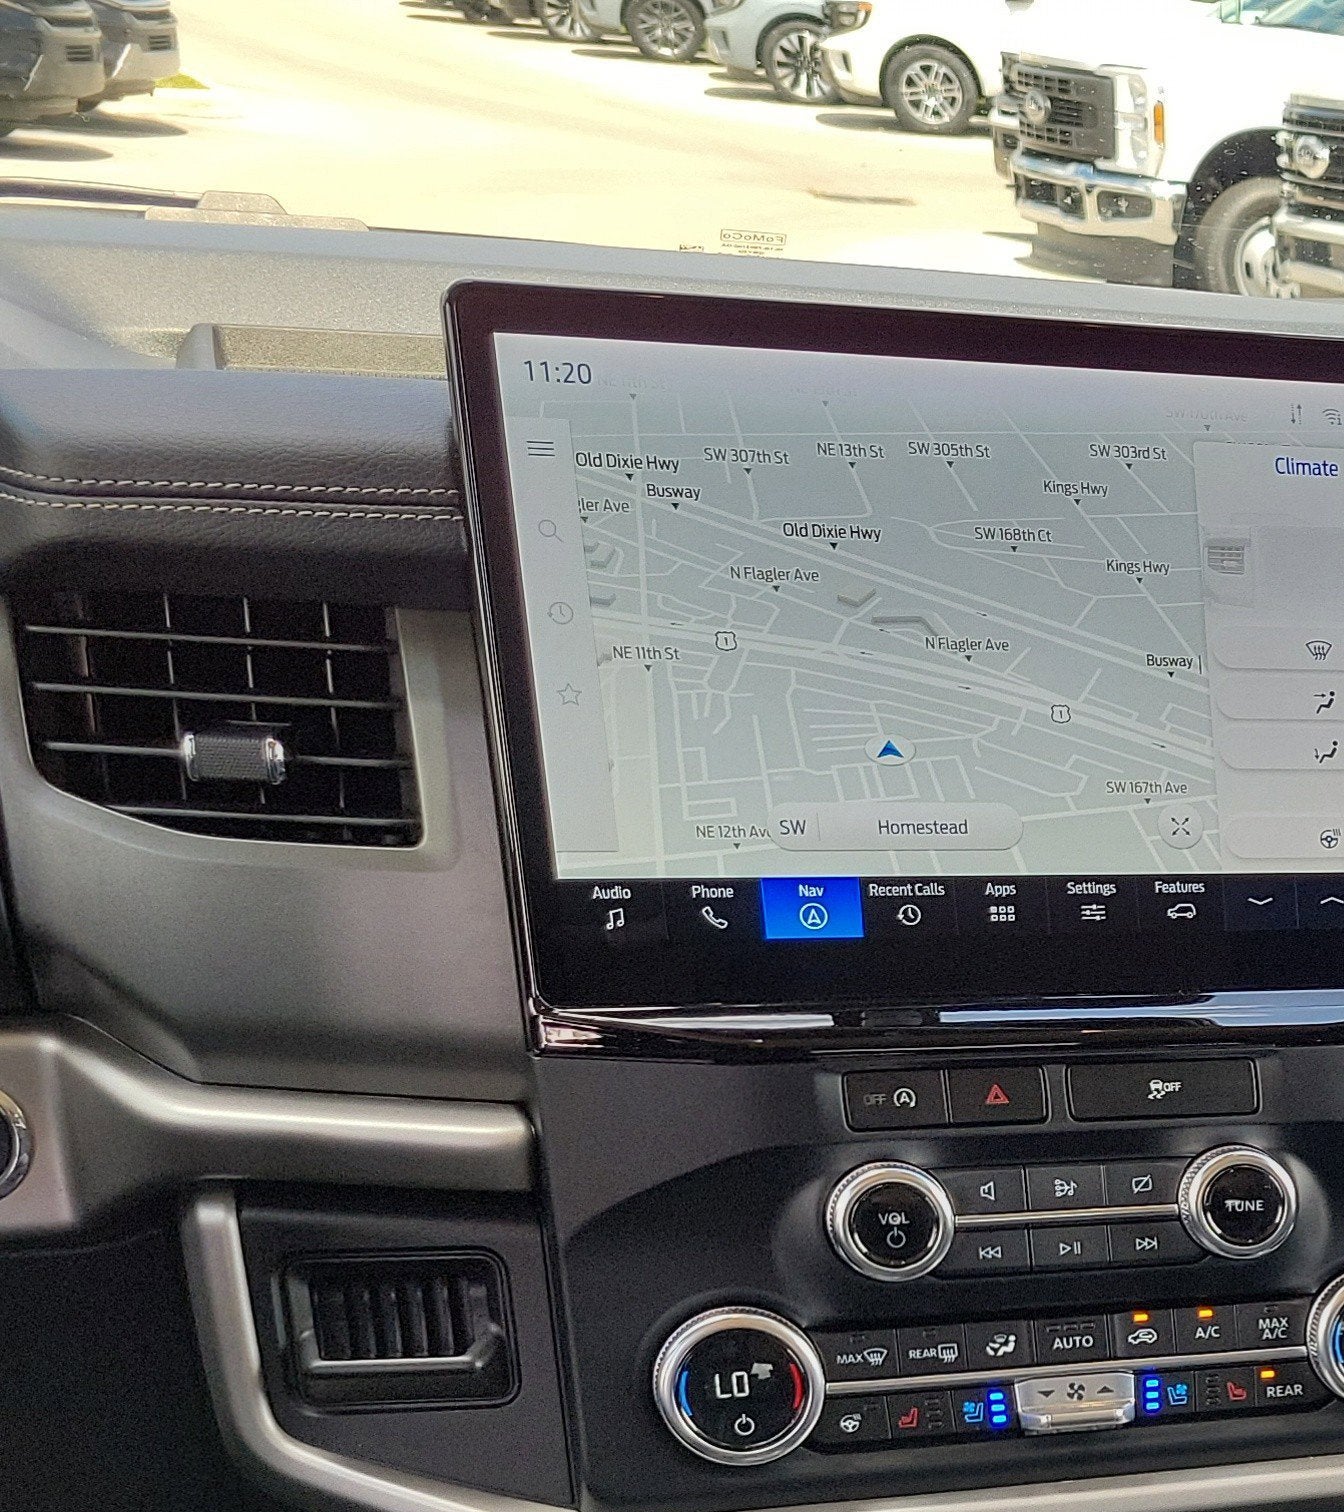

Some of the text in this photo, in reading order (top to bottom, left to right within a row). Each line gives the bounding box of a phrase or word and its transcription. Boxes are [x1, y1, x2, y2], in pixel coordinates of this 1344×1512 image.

[523, 359, 593, 385] 11:20
[703, 447, 790, 464] SW 307th St
[817, 442, 884, 458] NE 13th St
[908, 441, 990, 458] SW 305th St
[1089, 445, 1167, 460] SW 303rd St
[575, 451, 680, 473] Old Dixie Hwy
[1275, 456, 1339, 477] Climate
[646, 484, 701, 502] Busway
[1043, 480, 1109, 497] Kings Hwy
[578, 497, 630, 514] ler Ave
[783, 523, 882, 543] Old Dixie Hwy
[974, 526, 1053, 543] SW 168th Ct
[730, 565, 820, 584] N Flagler Ave
[1106, 558, 1170, 576] Kings Hwy
[925, 636, 1009, 654] N Flagler Ave
[612, 646, 680, 661] NE 11th St
[1146, 654, 1194, 670] Busway
[1106, 781, 1188, 795] SW 167th Ave
[695, 825, 714, 838] NE
[717, 825, 746, 839] 12th
[779, 818, 969, 836] SW Homestead
[592, 885, 631, 900] Audio
[691, 884, 734, 899] Phone
[798, 884, 824, 897] Nav
[868, 882, 945, 897] Recent Calls
[985, 882, 1017, 898] Apps
[1066, 881, 1117, 896] Settings
[1154, 880, 1205, 894] Features
[1163, 1081, 1182, 1093] OFF
[863, 1093, 887, 1106] OFF
[1225, 1199, 1264, 1214] TUNE
[878, 1212, 911, 1226] VOL
[1258, 1317, 1289, 1330] MAX
[1195, 1325, 1221, 1340] A/C
[1262, 1327, 1288, 1341] A/C
[1053, 1335, 1094, 1351] AUTO
[836, 1353, 865, 1365] MAX
[908, 1348, 937, 1361] REAR
[714, 1370, 750, 1399] LO
[1266, 1384, 1303, 1398] REAR
